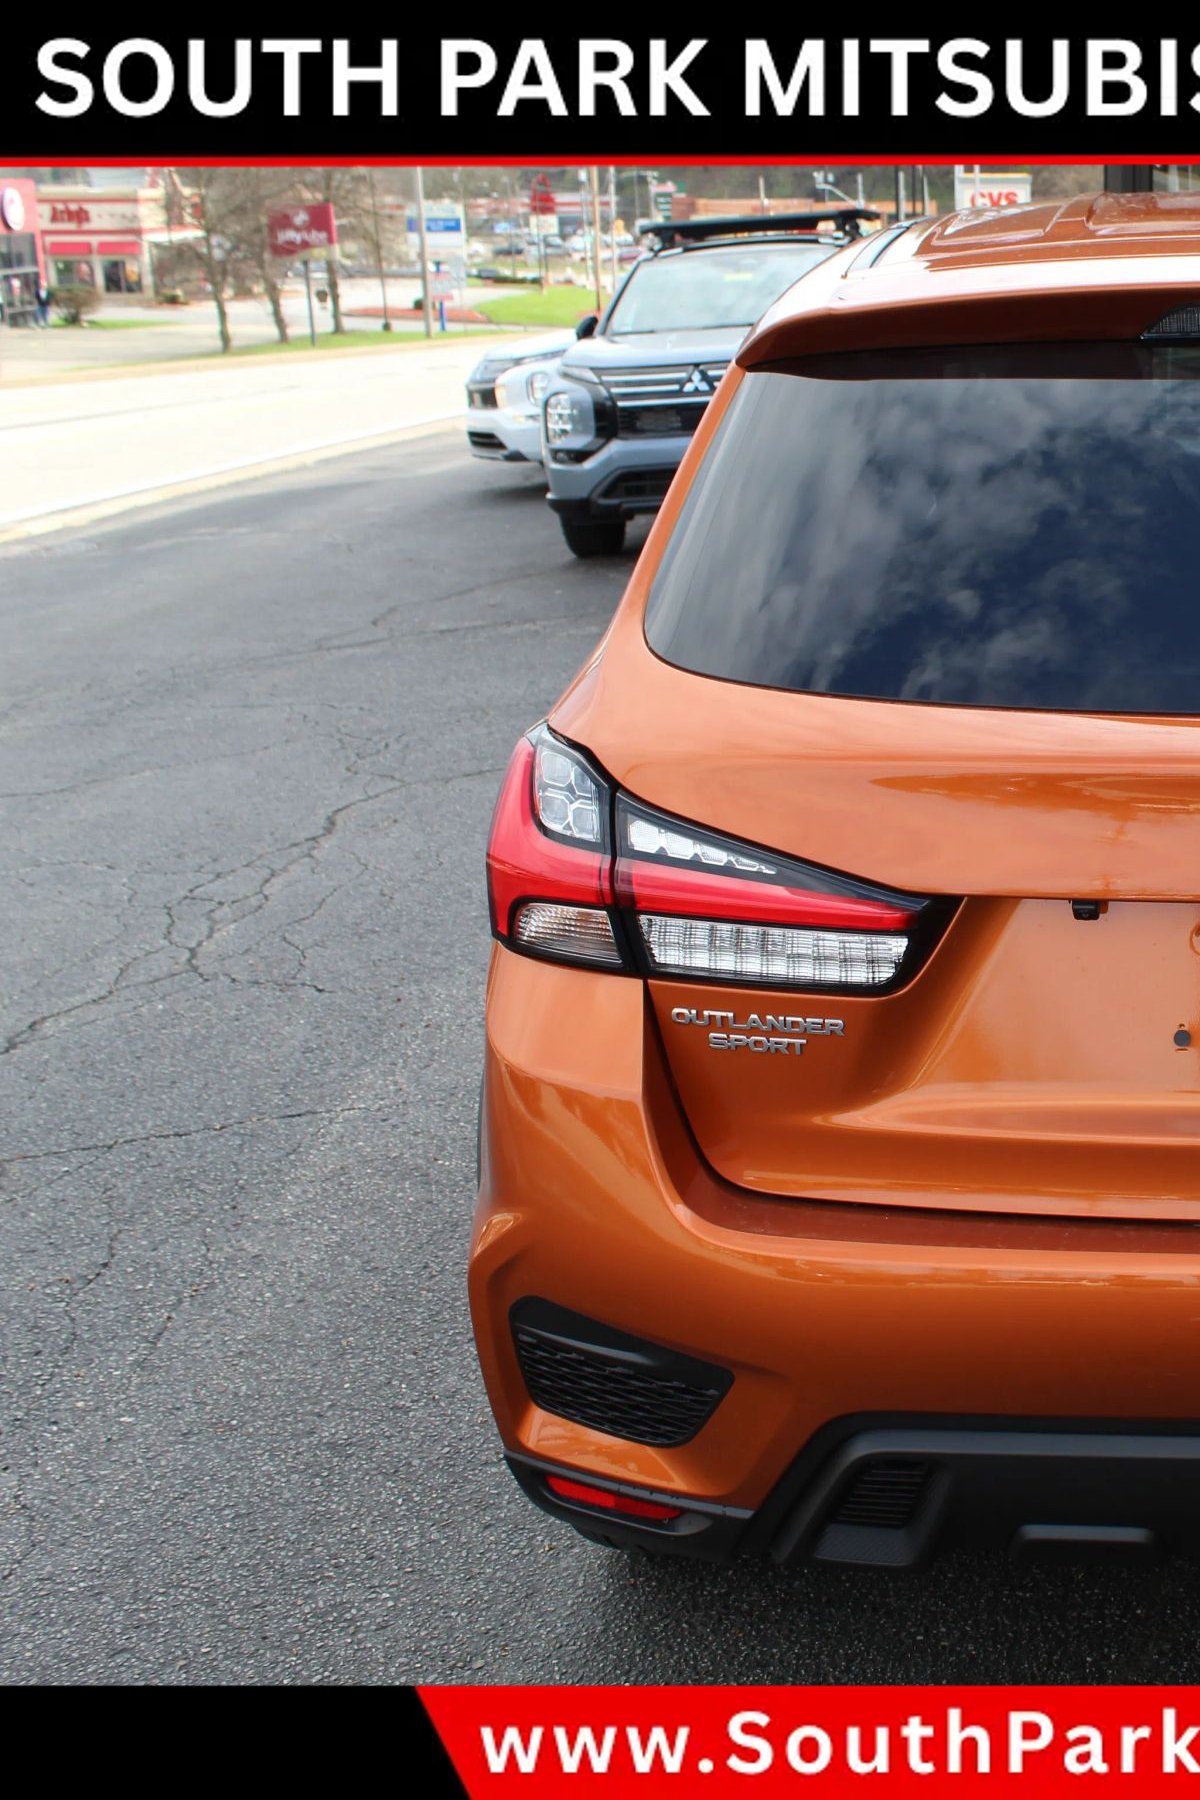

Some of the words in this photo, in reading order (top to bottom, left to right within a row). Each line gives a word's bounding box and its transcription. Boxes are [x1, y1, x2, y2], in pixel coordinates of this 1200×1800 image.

[970, 191, 1018, 208] CVS
[671, 1007, 845, 1037] OUTLANDER
[708, 1032, 807, 1056] SPORT
